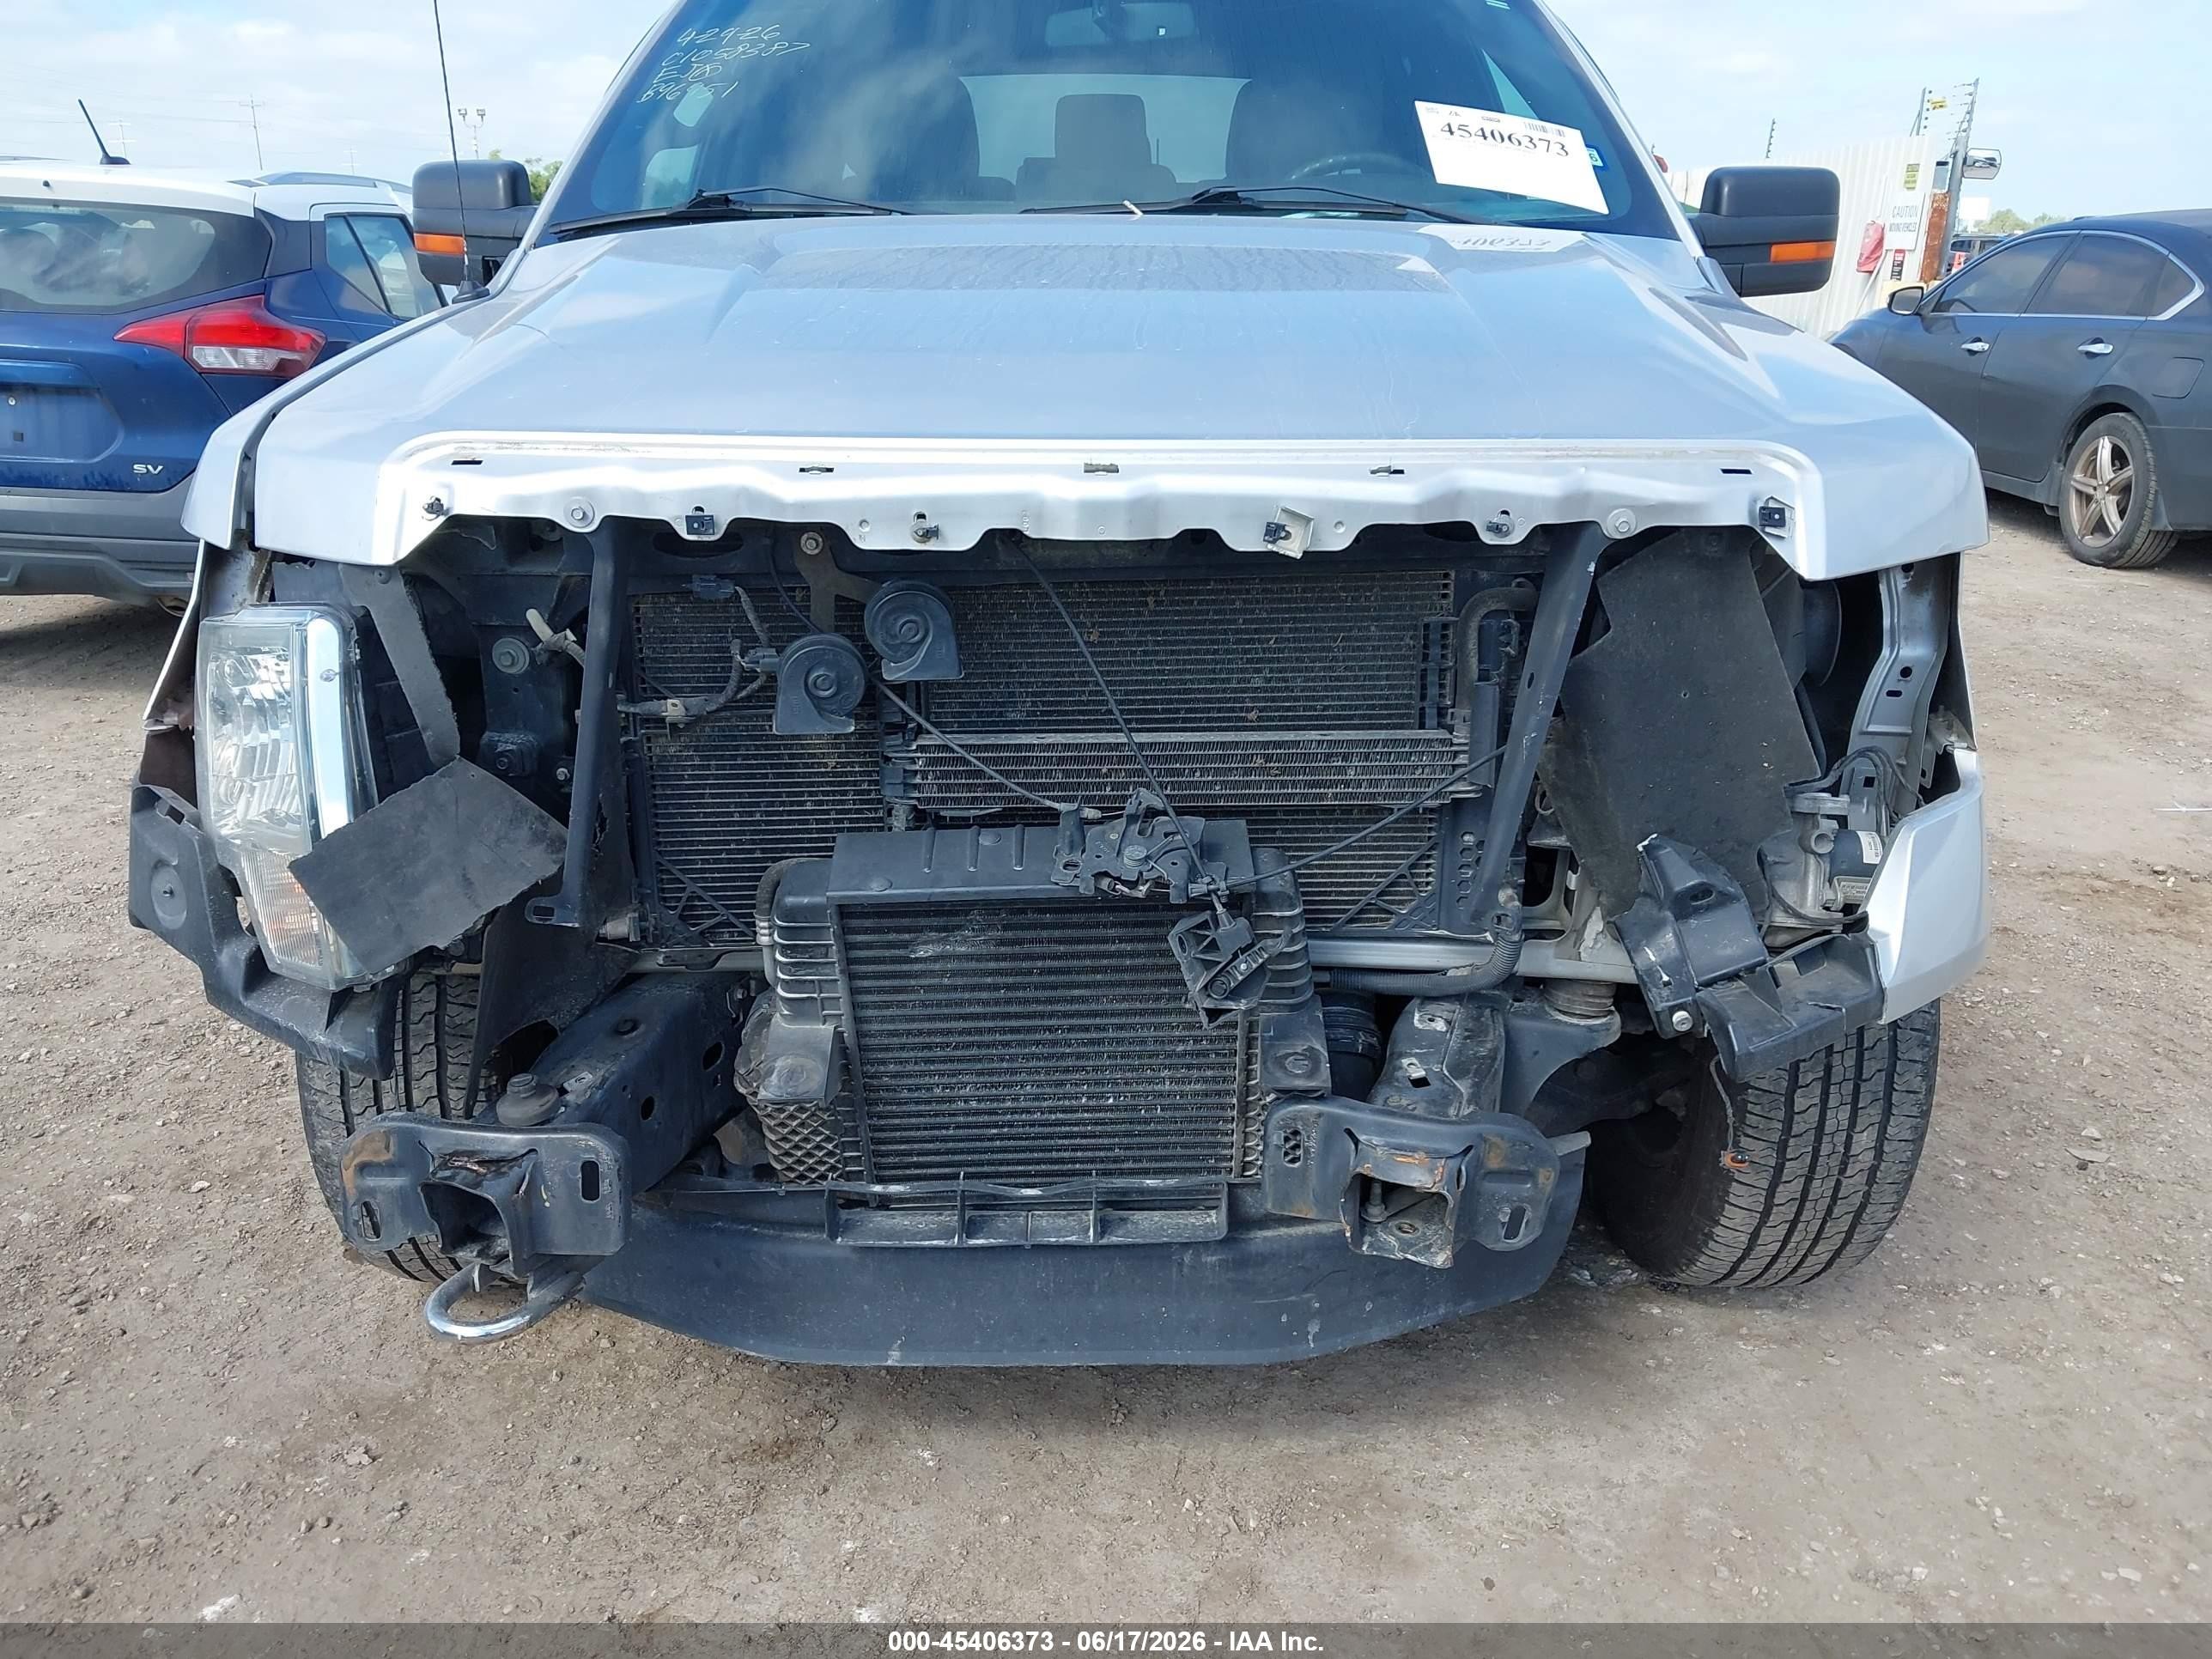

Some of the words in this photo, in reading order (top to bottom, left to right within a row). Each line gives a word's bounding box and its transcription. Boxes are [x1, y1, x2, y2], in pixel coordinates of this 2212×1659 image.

[1441, 122, 1569, 156] 45406373
[1892, 205, 1918, 218] CAUTION
[132, 464, 164, 475] SV
